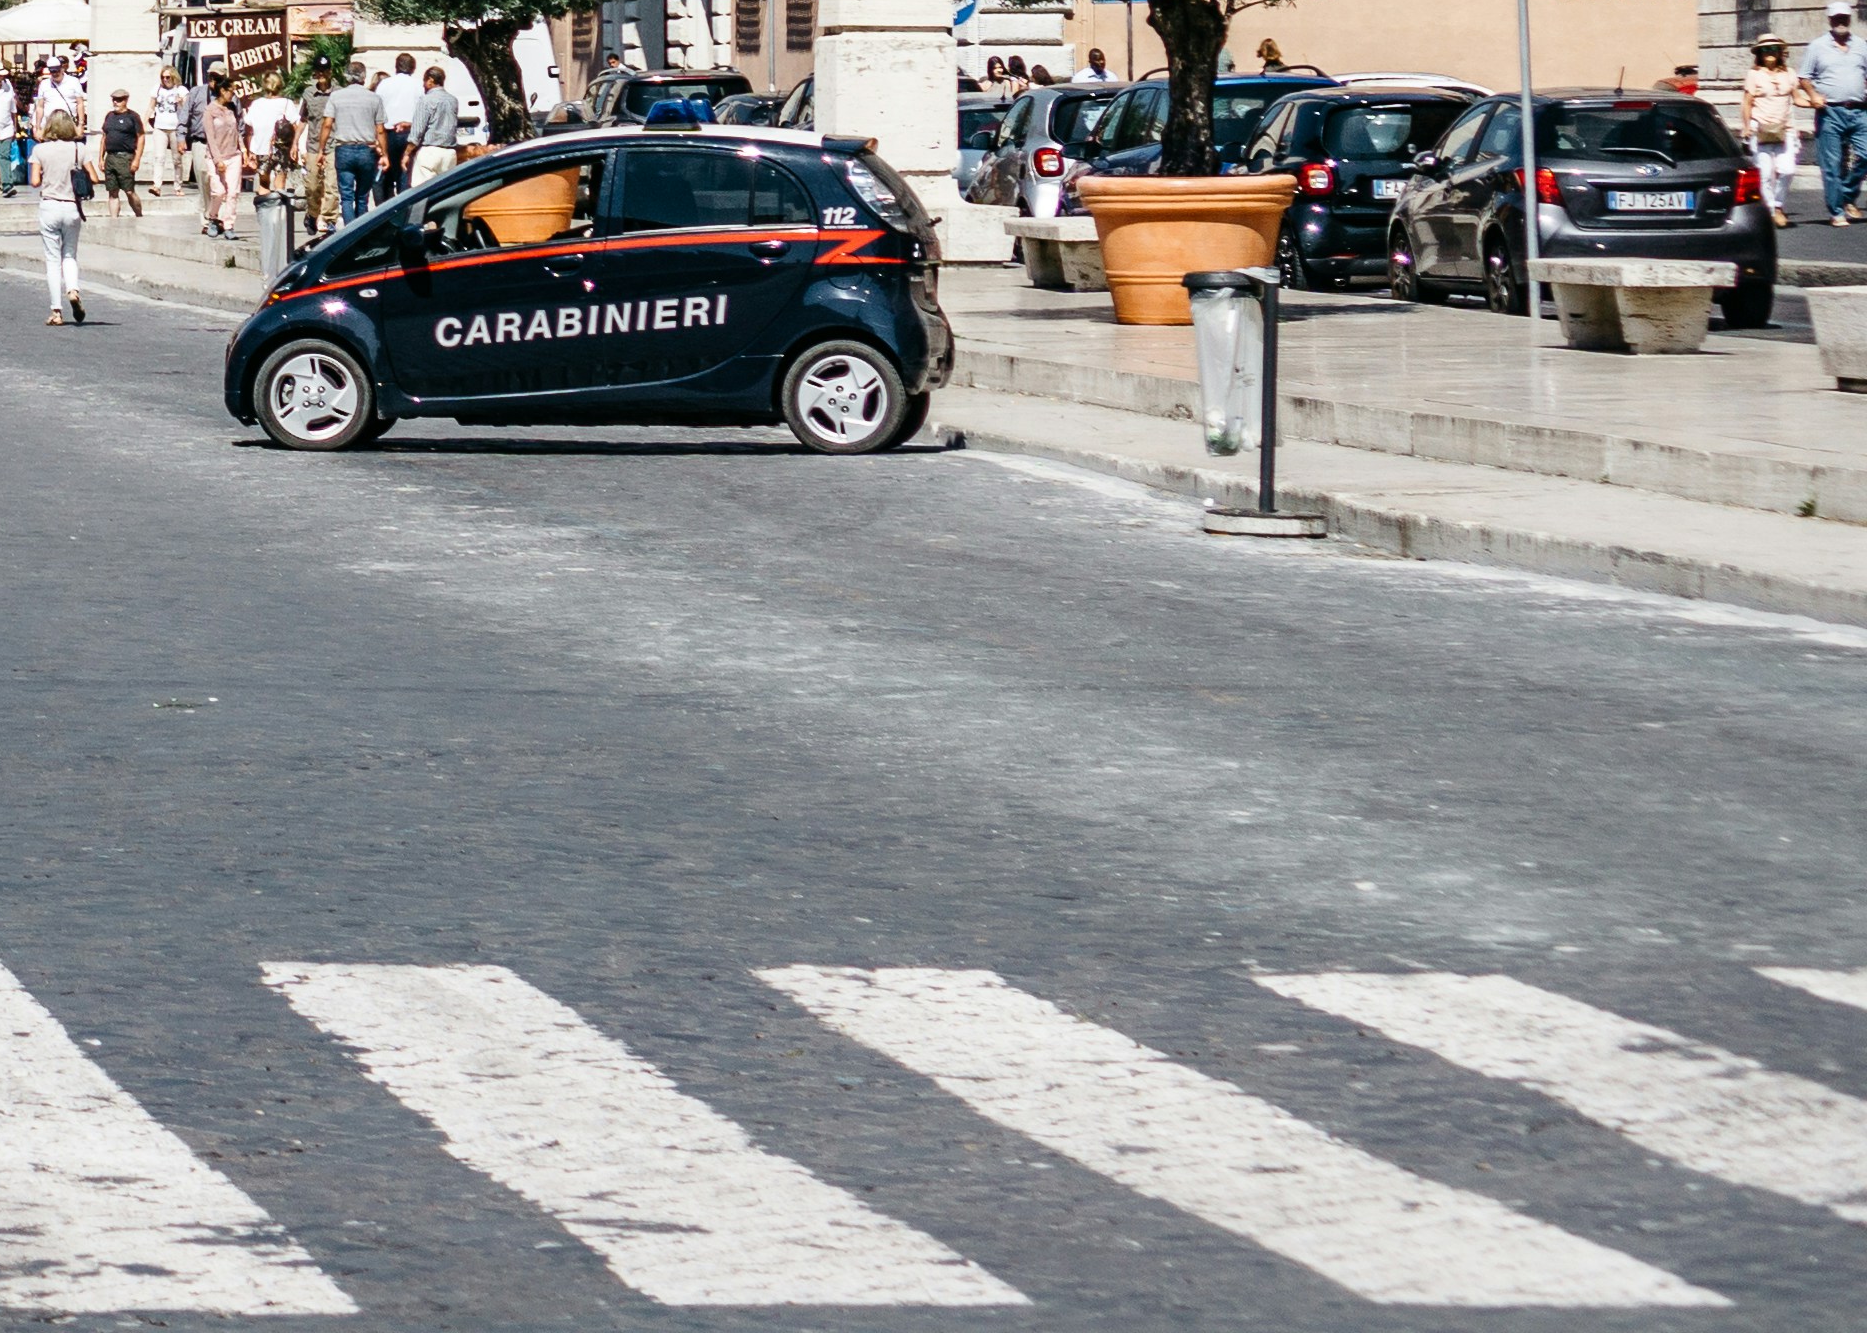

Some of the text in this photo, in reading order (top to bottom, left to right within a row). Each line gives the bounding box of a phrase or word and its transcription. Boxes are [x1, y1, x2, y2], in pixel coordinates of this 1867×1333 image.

[189, 17, 282, 38] ICE CREAM
[230, 41, 283, 71] BIBITE
[822, 206, 857, 225] 112
[435, 294, 728, 348] CARABINIERI
